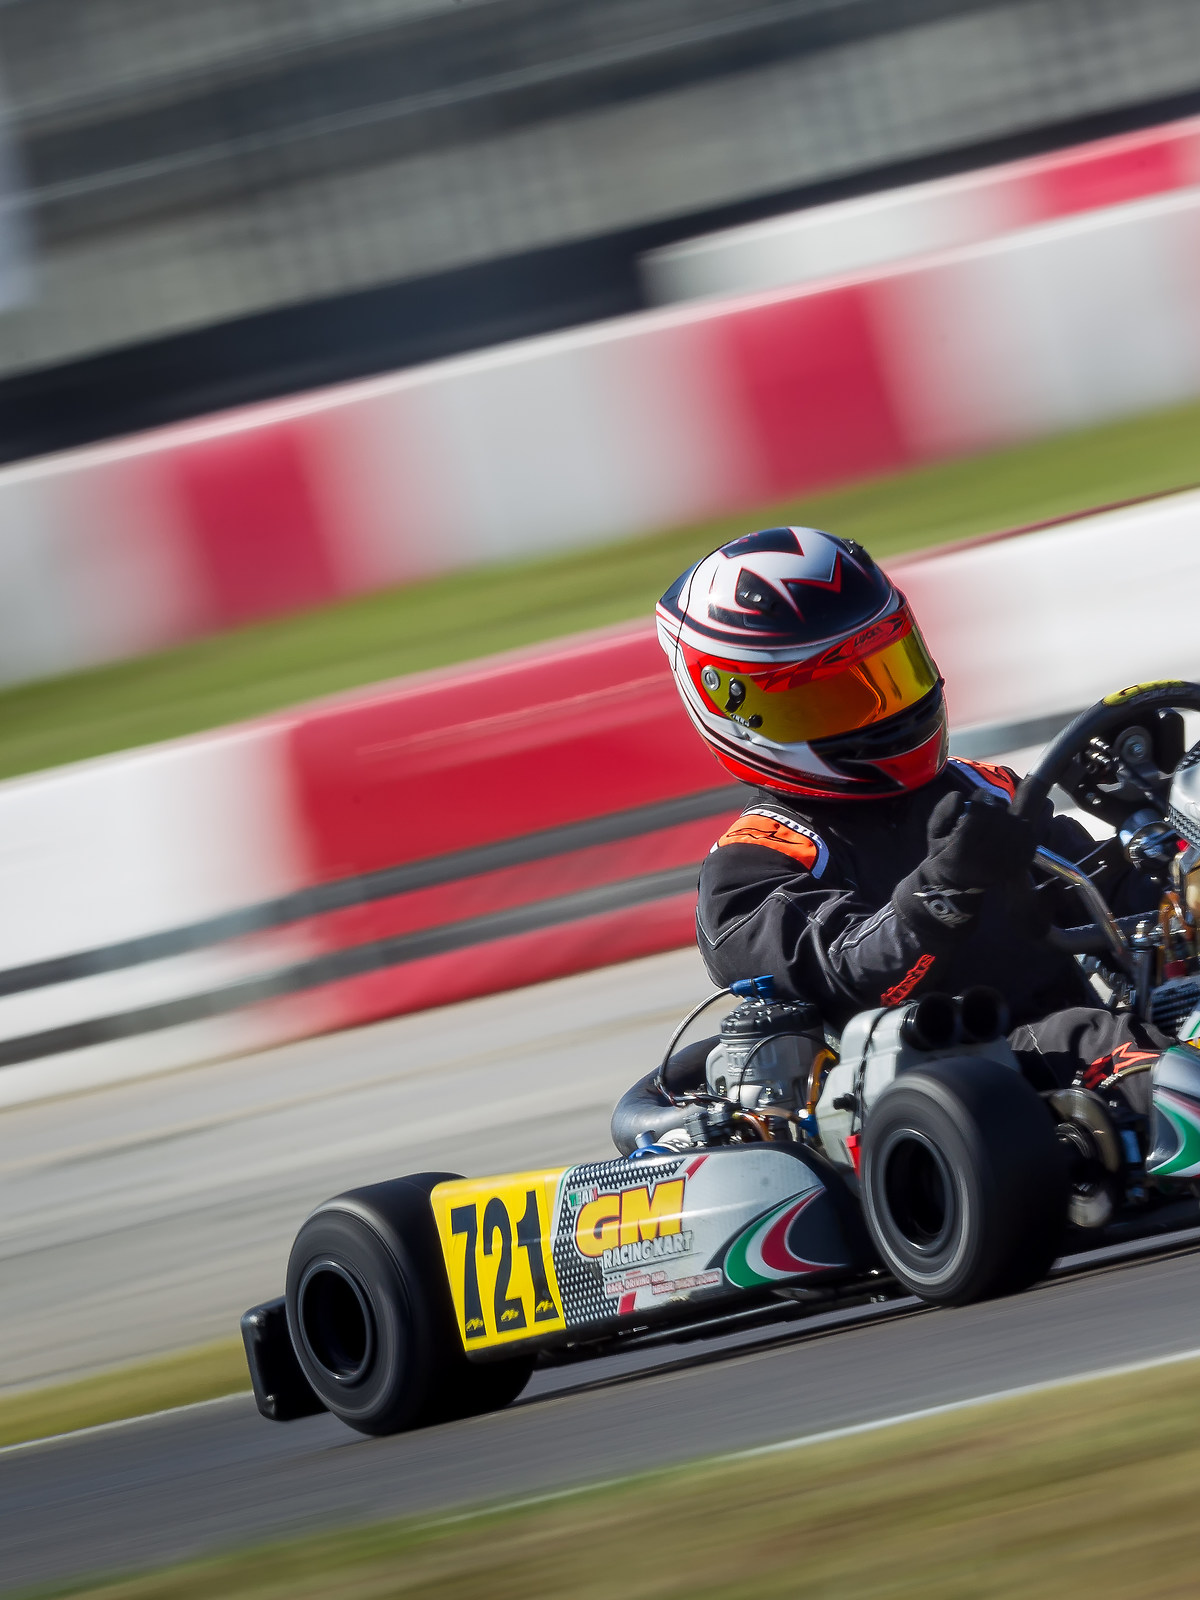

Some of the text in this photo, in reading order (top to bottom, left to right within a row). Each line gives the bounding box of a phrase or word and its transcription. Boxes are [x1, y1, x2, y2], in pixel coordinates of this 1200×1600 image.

[569, 1187, 598, 1207] TEAM
[576, 1177, 686, 1258] GM
[451, 1190, 559, 1338] 721
[603, 1230, 693, 1269] RACING KART
